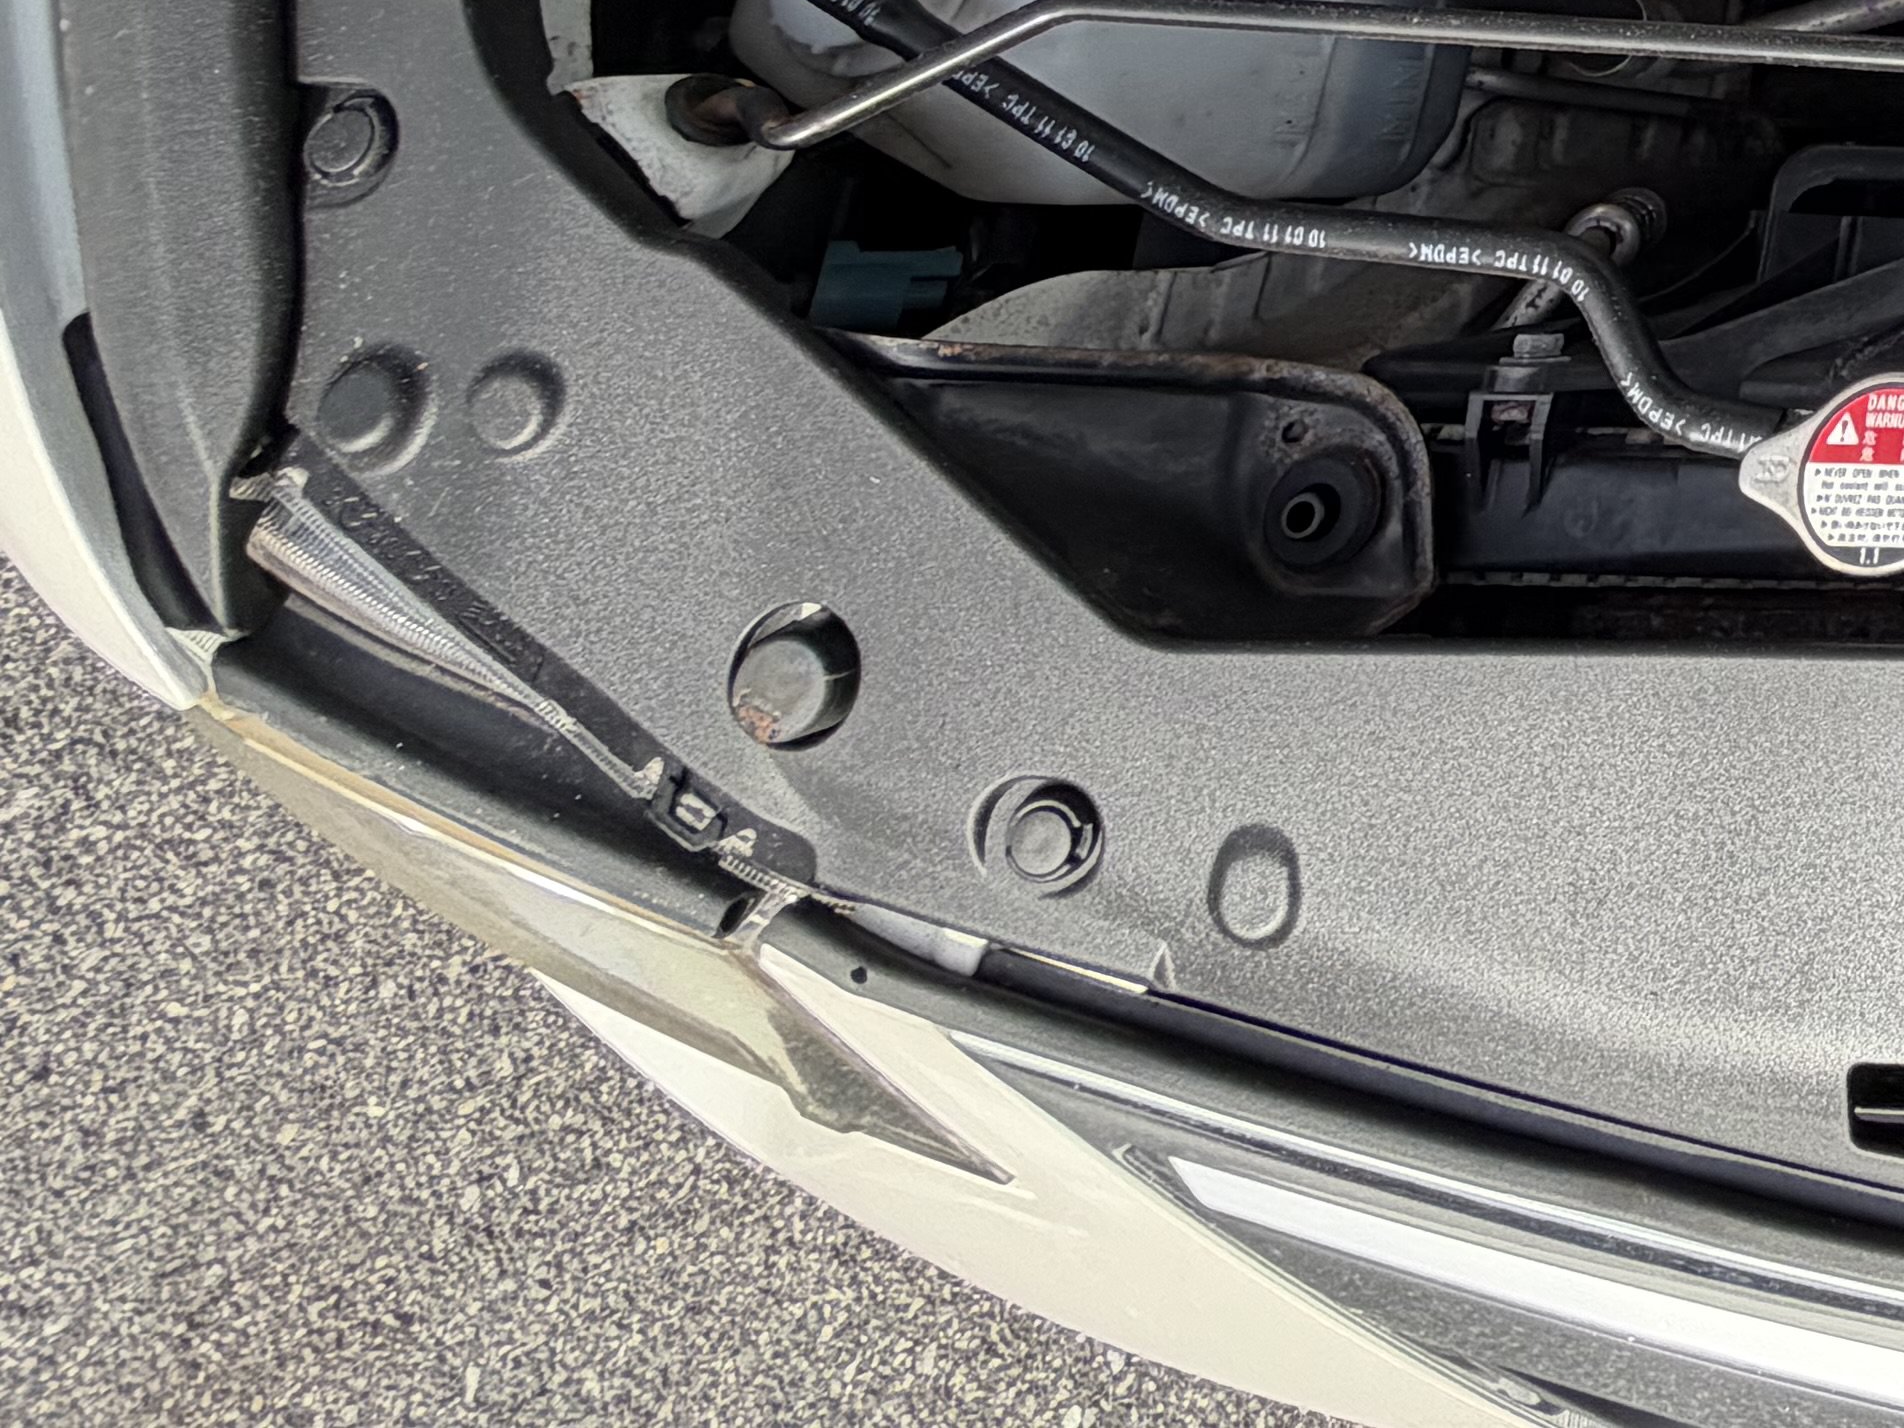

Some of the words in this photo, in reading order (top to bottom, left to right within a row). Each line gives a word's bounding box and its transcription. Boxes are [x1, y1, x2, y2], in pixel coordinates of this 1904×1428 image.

[1000, 94, 1037, 125] TPC
[1073, 140, 1096, 162] 10
[1219, 216, 1254, 240] TPC
[1263, 223, 1278, 244] 11
[1308, 229, 1326, 248] 10
[1408, 242, 1481, 266] >EPDM<
[1493, 249, 1527, 271] TPC
[1532, 254, 1549, 275] 11
[1552, 260, 1573, 285] 01
[1571, 279, 1590, 302] 10
[1699, 422, 1733, 448] TPC
[1824, 468, 1846, 479] NEVER
[1852, 468, 1873, 479] OPEN
[1859, 548, 1880, 565] 1.1
